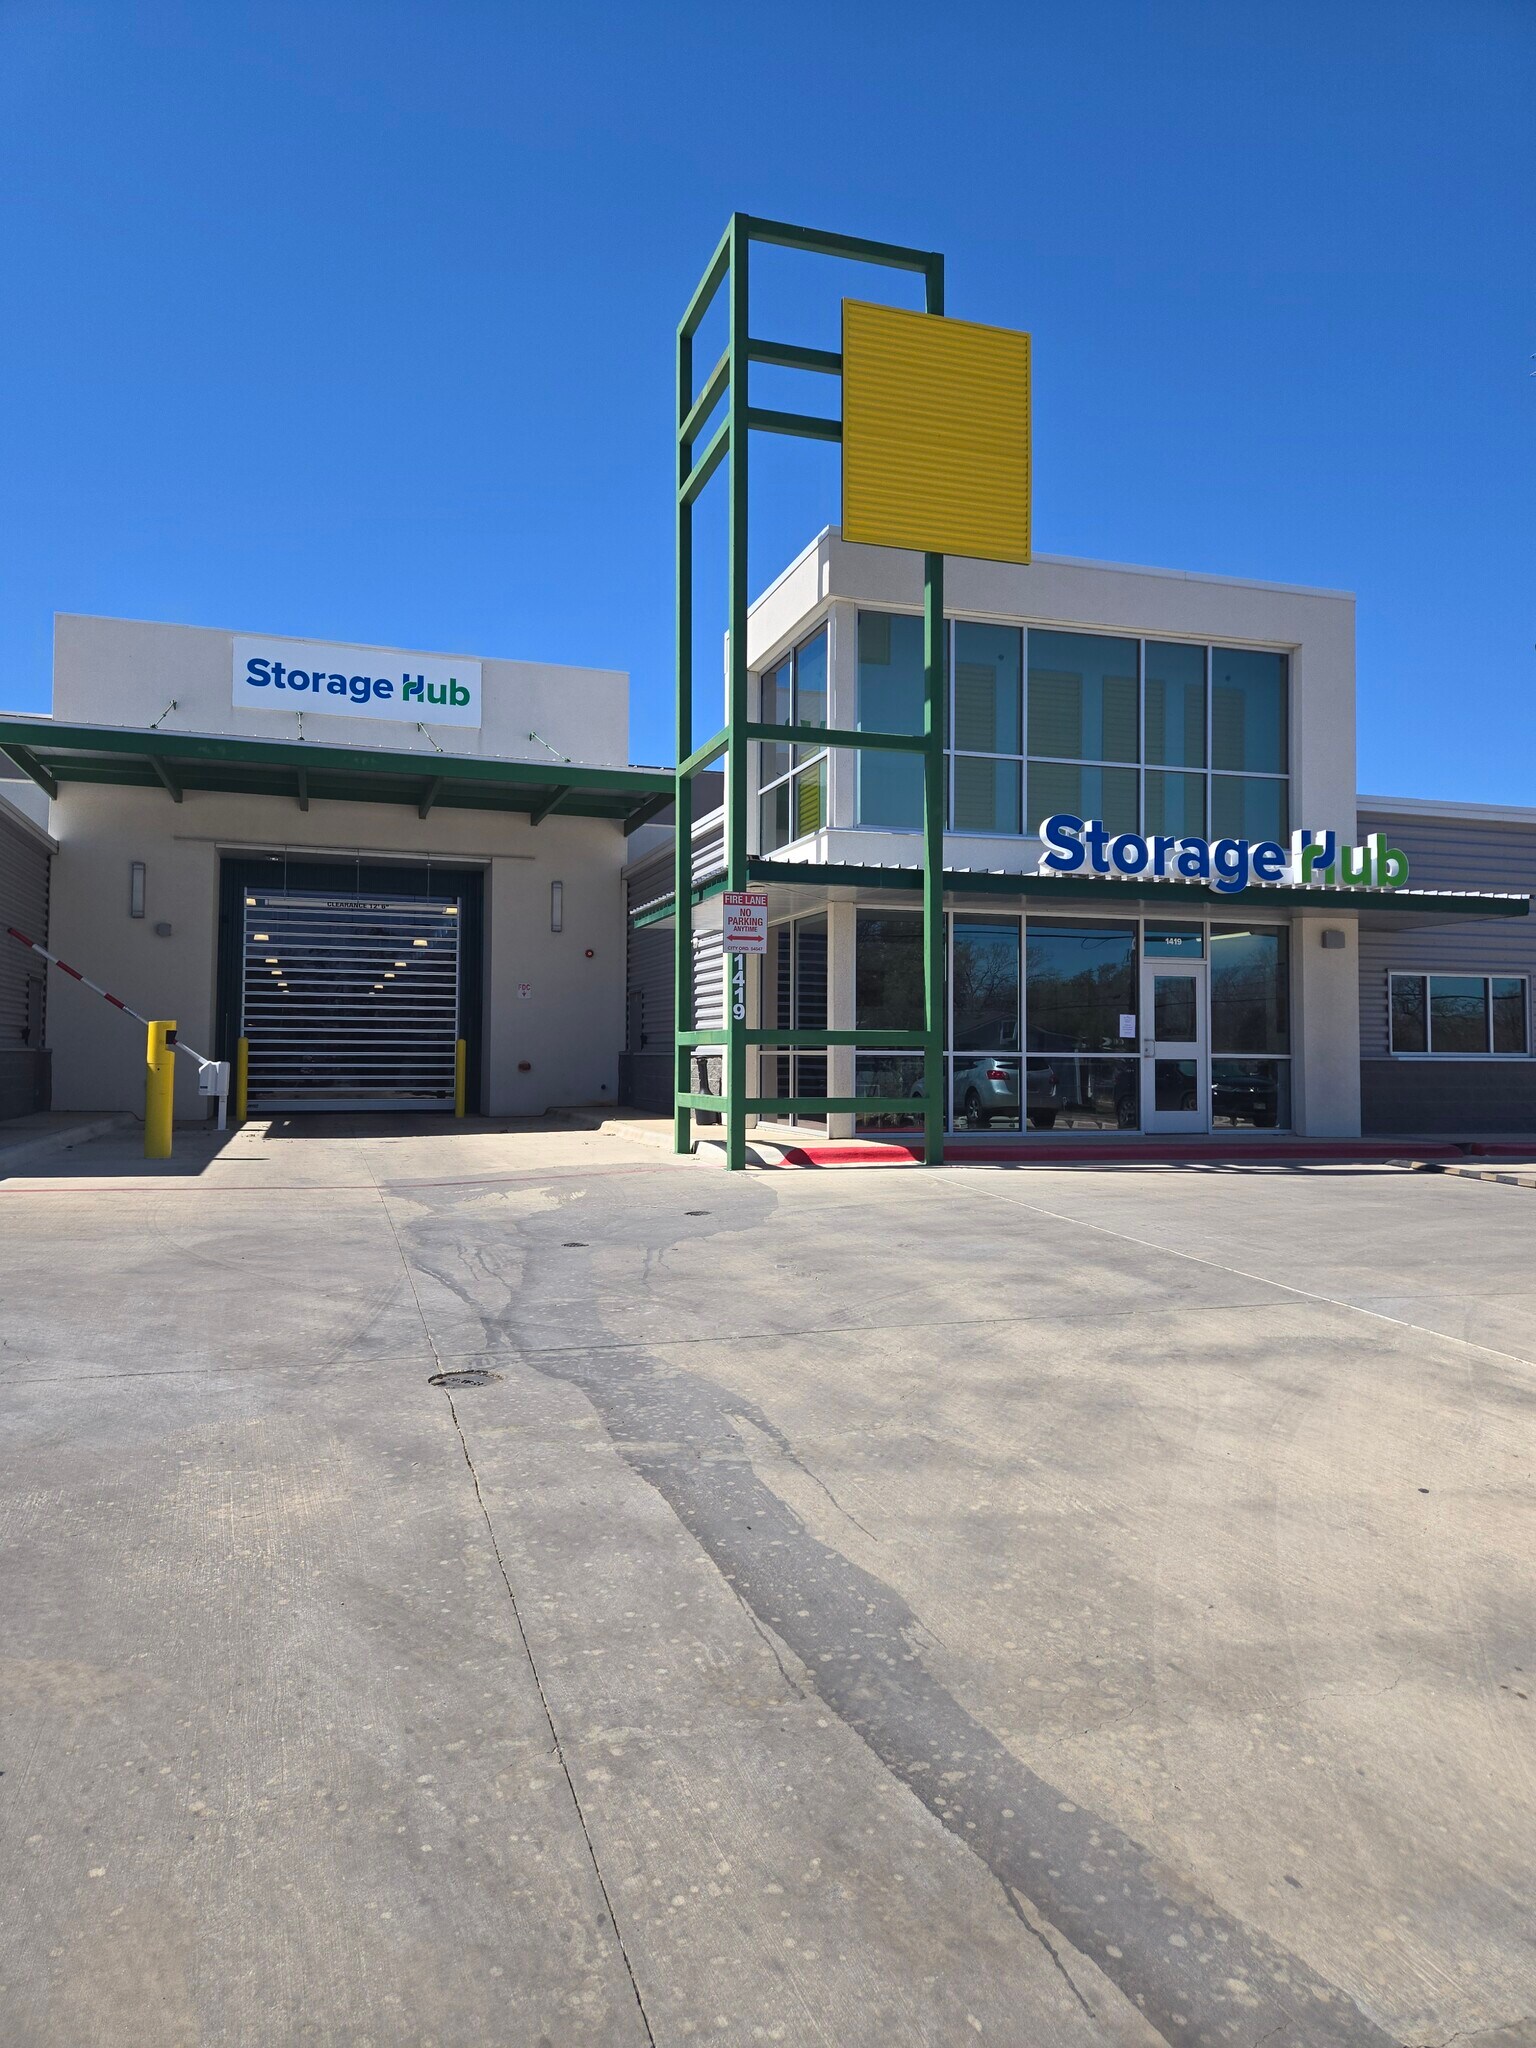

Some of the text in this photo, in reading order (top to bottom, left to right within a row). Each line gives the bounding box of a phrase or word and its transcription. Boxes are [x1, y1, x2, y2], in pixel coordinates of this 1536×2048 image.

[246, 657, 471, 707] Storage Hub
[1041, 813, 1410, 894] Storage Hub
[326, 901, 367, 909] CLEARANCE
[724, 895, 767, 905] FIRE LANE
[739, 908, 752, 917] NO
[727, 916, 764, 927] PARKING
[1165, 937, 1183, 945] 1419
[518, 983, 531, 991] FDC
[732, 953, 746, 1020] 1419
